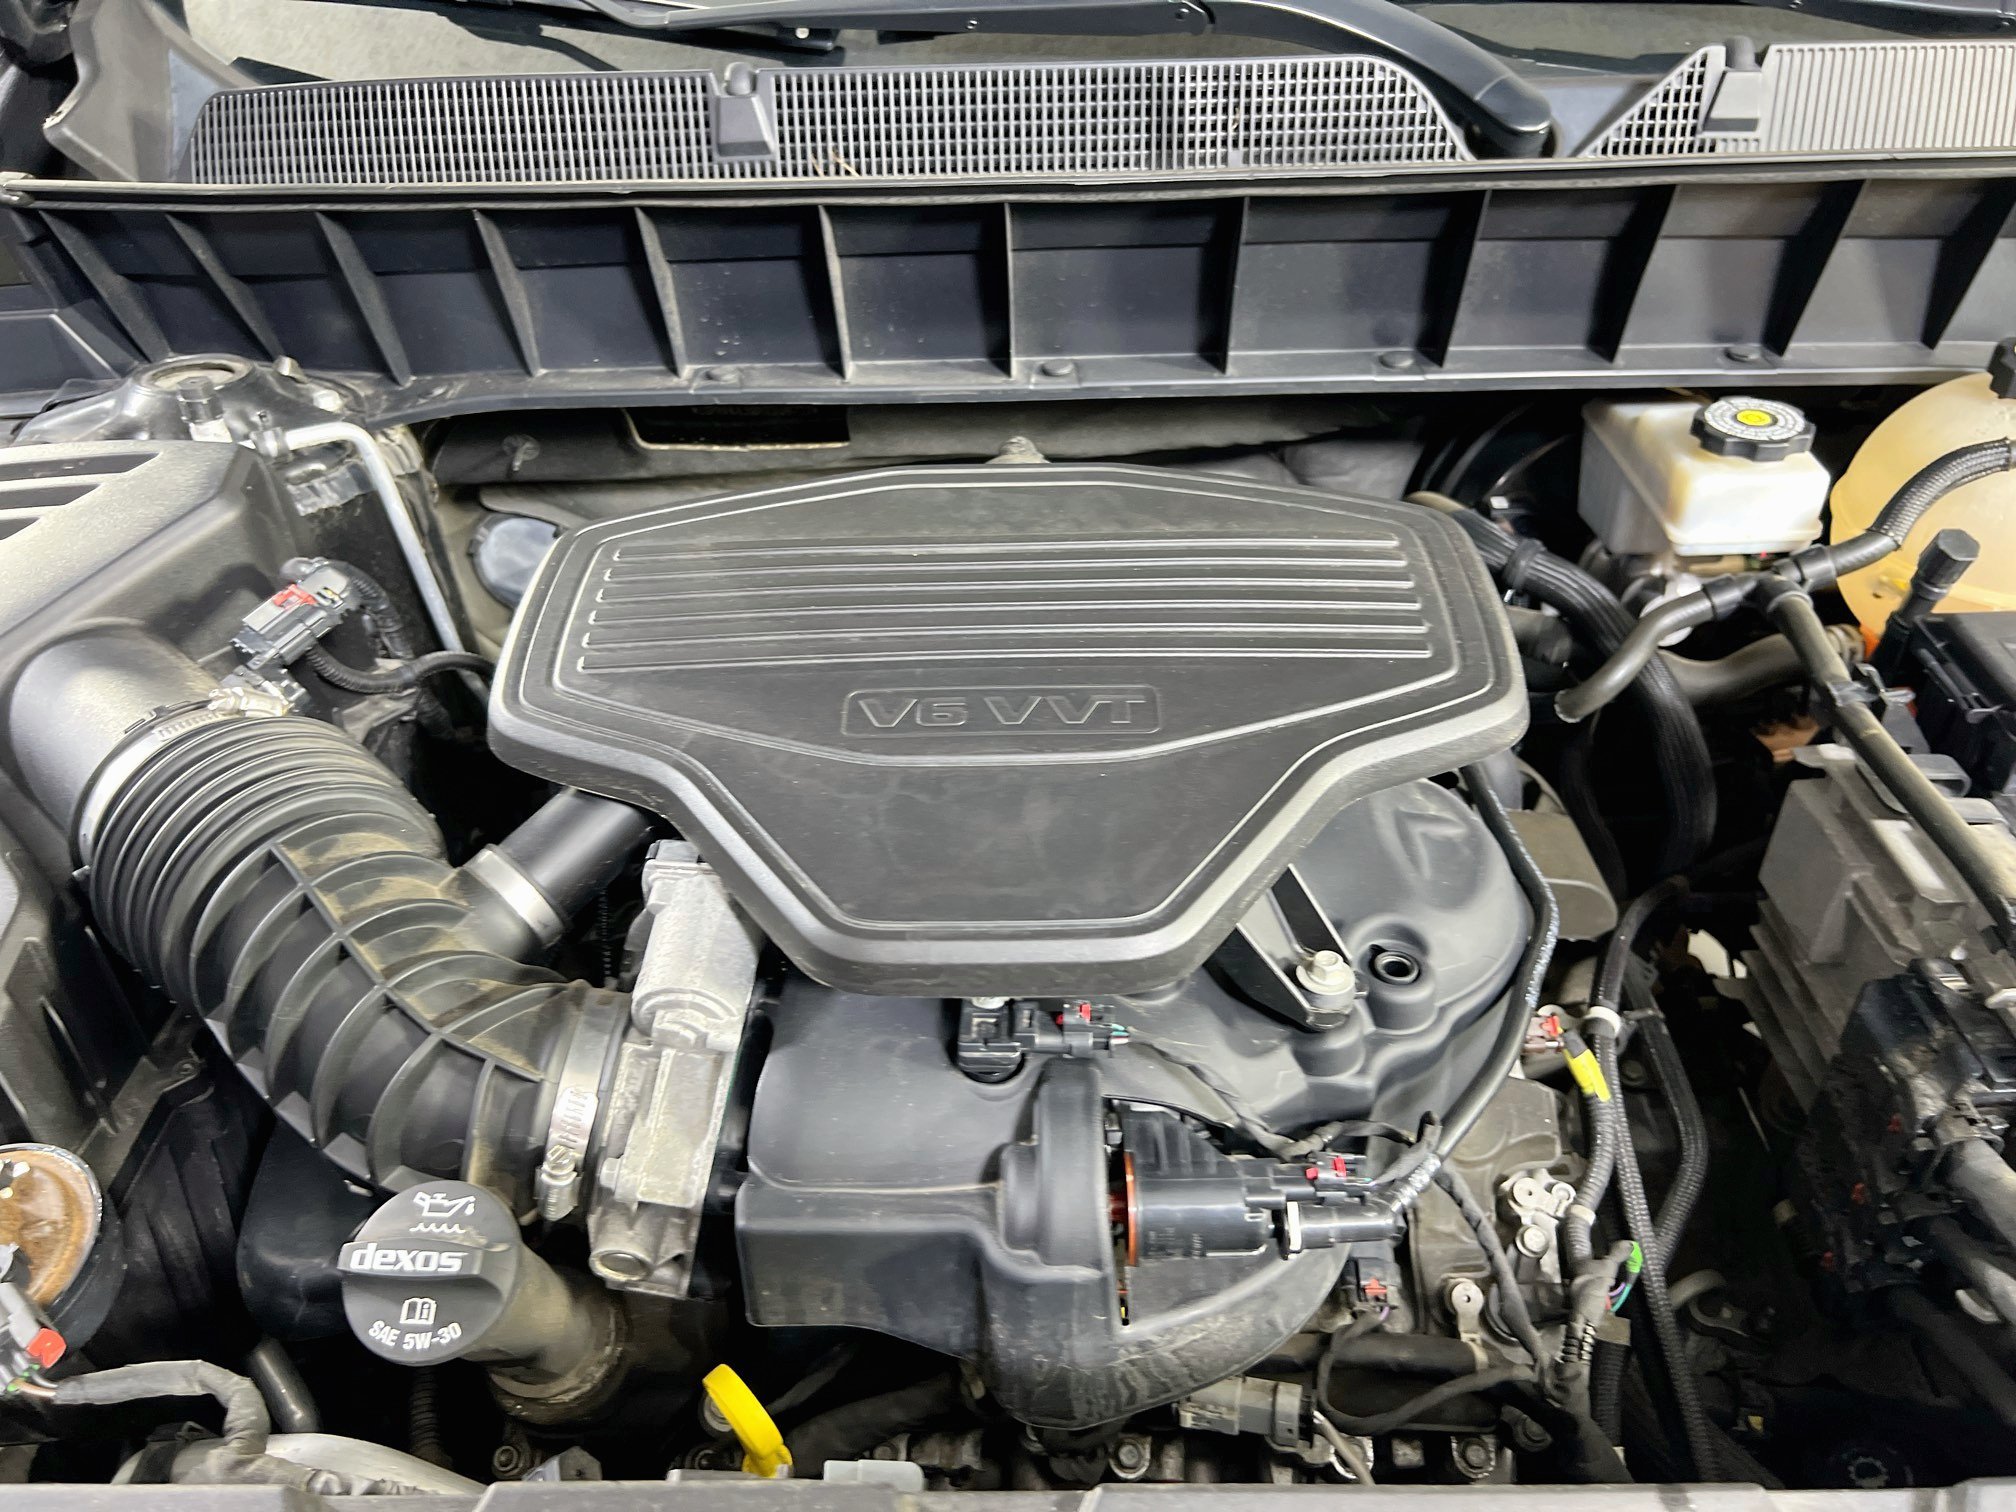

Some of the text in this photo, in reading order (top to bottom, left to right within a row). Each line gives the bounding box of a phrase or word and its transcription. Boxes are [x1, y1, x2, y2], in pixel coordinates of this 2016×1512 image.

[857, 694, 1147, 728] V6 VVT
[350, 1242, 469, 1272] dexos
[368, 1320, 462, 1350] SAE 5W-30
